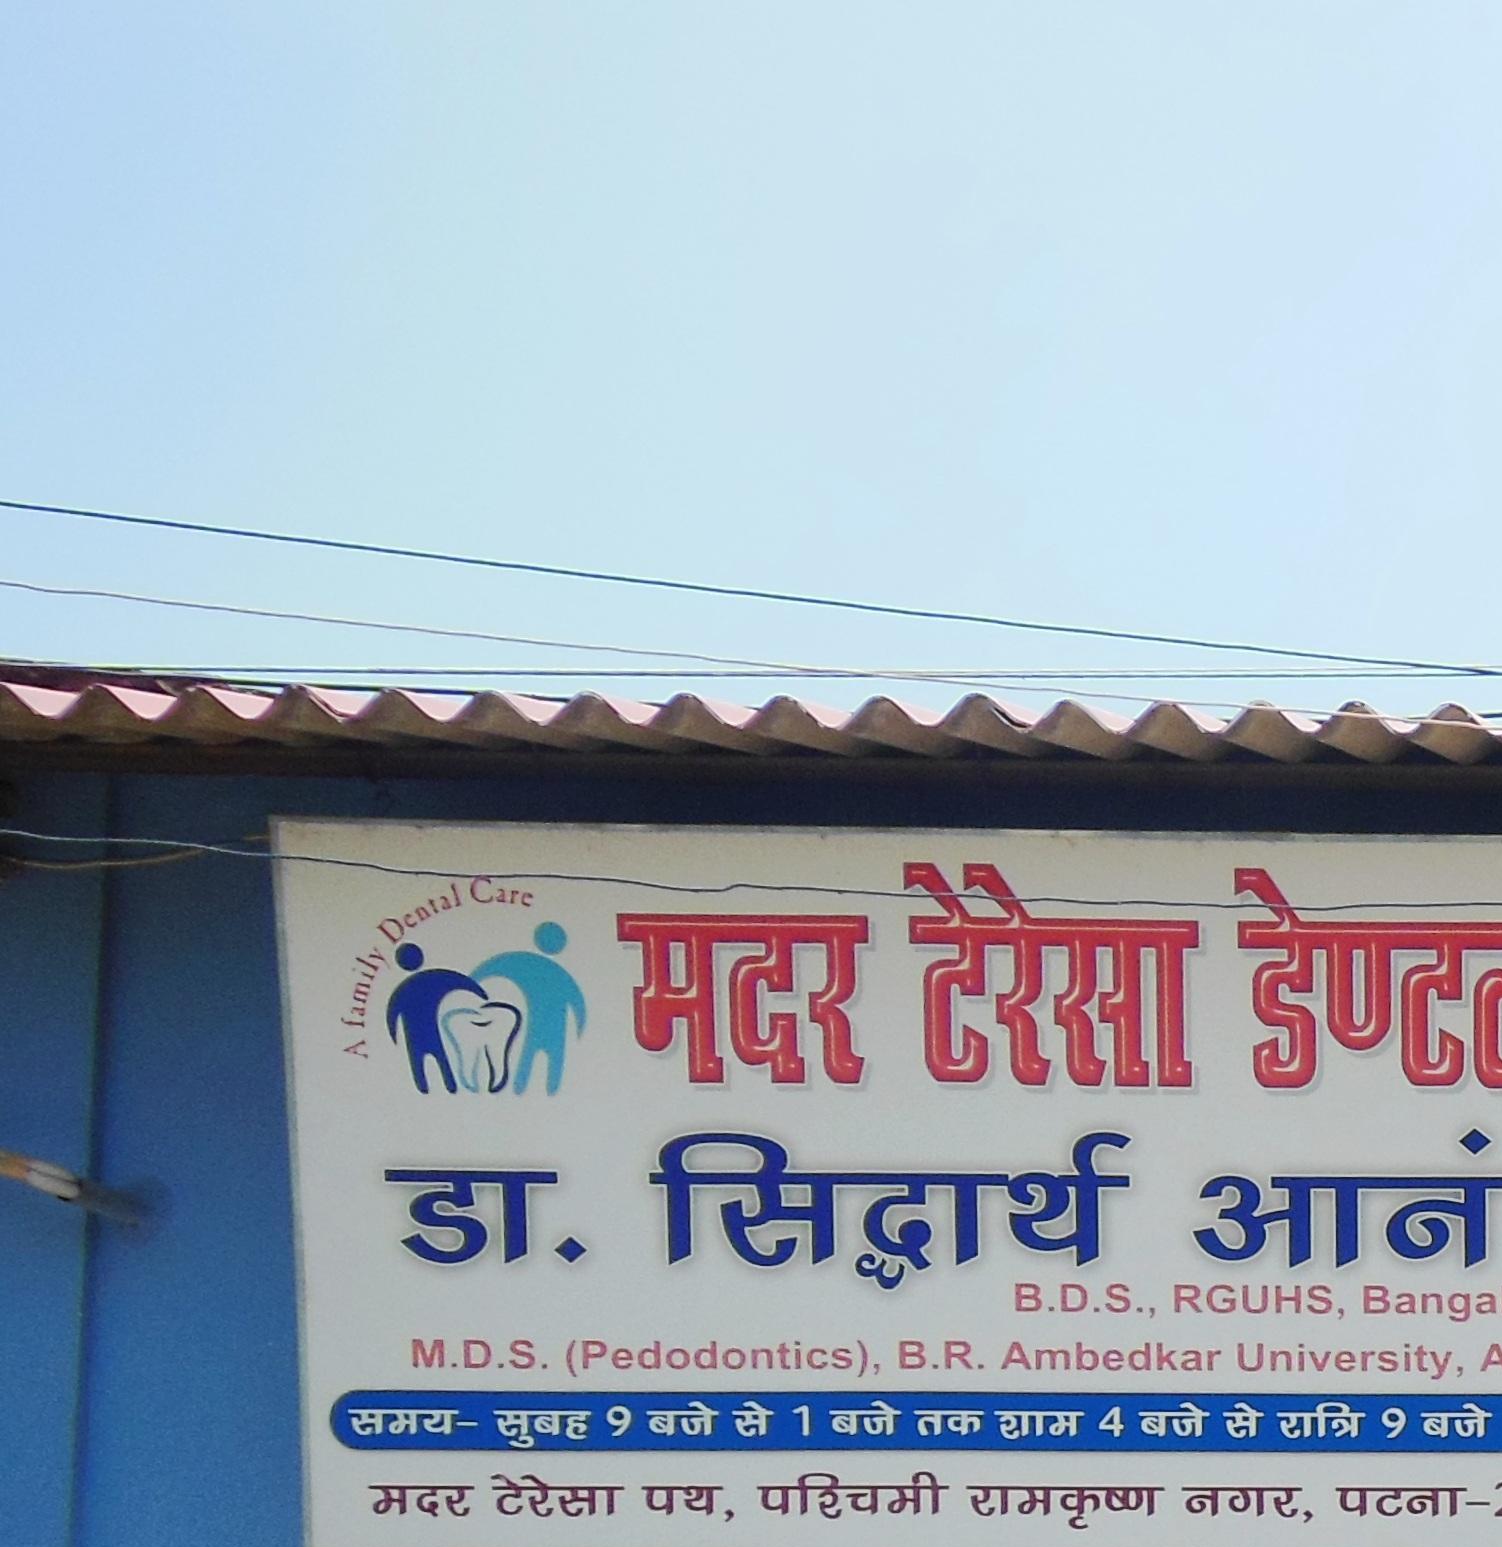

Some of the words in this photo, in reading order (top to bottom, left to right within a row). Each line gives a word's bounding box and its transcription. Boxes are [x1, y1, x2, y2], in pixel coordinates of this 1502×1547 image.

[376, 882, 462, 947] Dental
[470, 876, 534, 907] Care
[341, 947, 391, 1029] family
[615, 912, 870, 1085] मदर
[903, 862, 1199, 1086] टेरेसा
[343, 1039, 369, 1059] A
[383, 1168, 588, 1265] डा.
[1014, 1282, 1156, 1319] B.D.S.,
[1174, 1284, 1344, 1319] RGUHS,
[411, 1338, 548, 1370] M.D.S.
[565, 1339, 880, 1378] (Pedodontics),
[899, 1340, 985, 1370] B.R.
[1000, 1341, 1222, 1372] Ambedkar
[1237, 1342, 1464, 1380] University,
[492, 1409, 592, 1449] सुबह
[606, 1405, 632, 1437] 9
[645, 1400, 720, 1436] बजे
[731, 1400, 775, 1437] से
[791, 1404, 810, 1437] 1
[828, 1400, 903, 1436] बजे
[913, 1409, 985, 1436] तक
[993, 1410, 1086, 1440] शाम
[1098, 1406, 1125, 1438] 4
[1137, 1401, 1211, 1438] बजे
[1222, 1402, 1265, 1439] से
[1275, 1401, 1367, 1439] रात्रि
[1381, 1407, 1407, 1439] 9
[1419, 1402, 1493, 1438] बजे
[367, 1484, 476, 1518] मदर
[490, 1473, 626, 1518] टेरेसा
[640, 1485, 735, 1523] पथ,
[965, 1485, 1166, 1530] रामकृष्ण
[1180, 1486, 1314, 1524] नगर,
